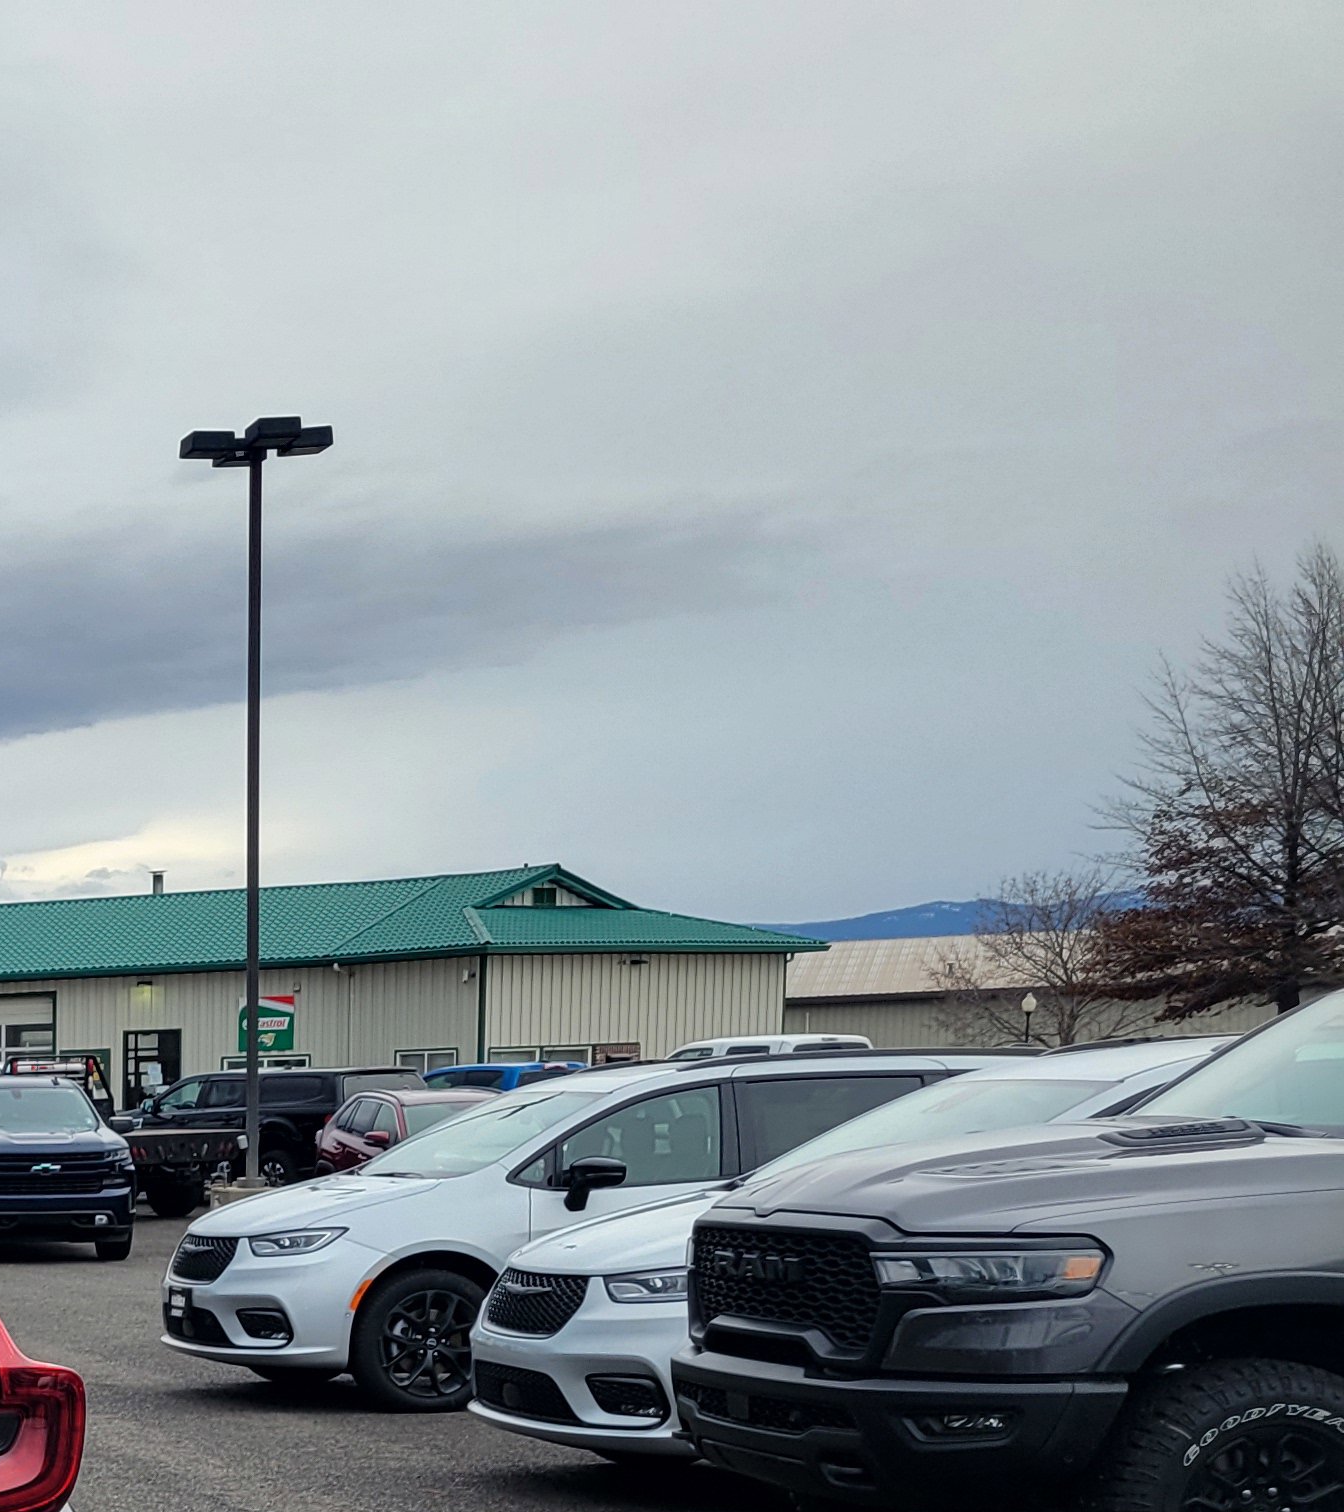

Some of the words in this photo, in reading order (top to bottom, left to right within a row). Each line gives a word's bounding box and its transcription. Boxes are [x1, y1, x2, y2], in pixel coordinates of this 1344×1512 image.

[258, 1019, 286, 1028] astrol
[713, 1247, 804, 1282] RAM
[1183, 1402, 1344, 1467] GOODYEA
